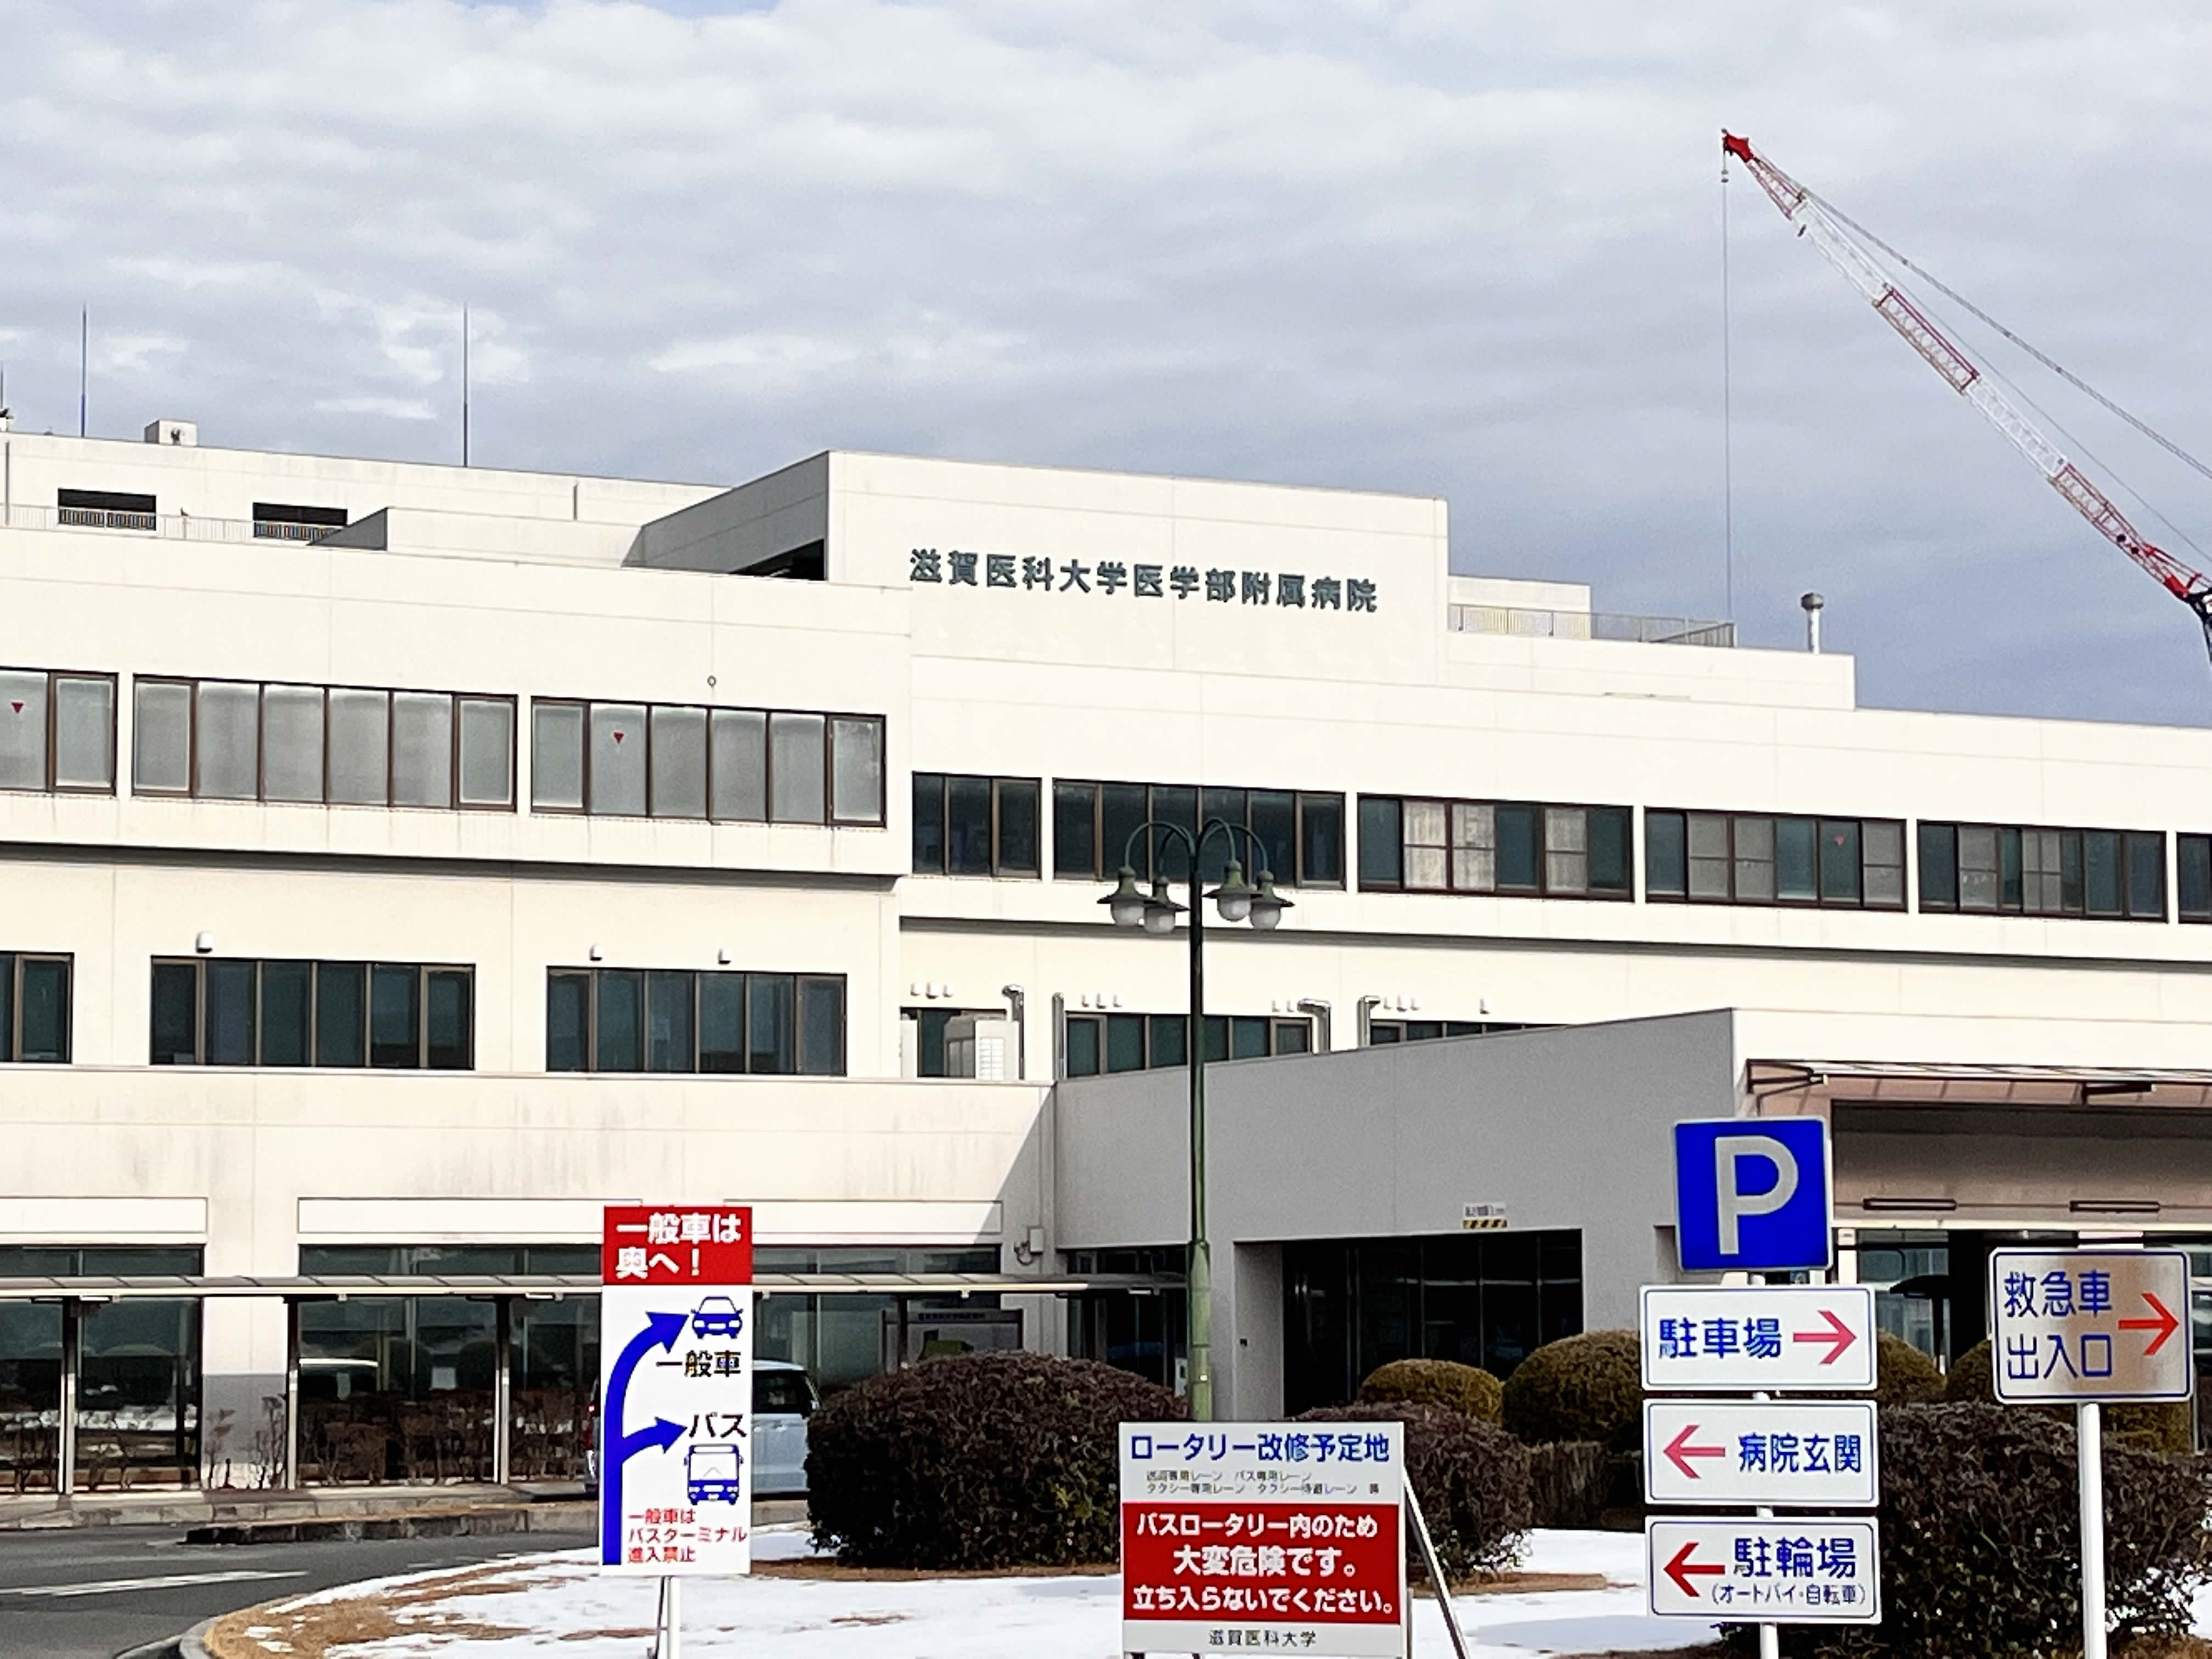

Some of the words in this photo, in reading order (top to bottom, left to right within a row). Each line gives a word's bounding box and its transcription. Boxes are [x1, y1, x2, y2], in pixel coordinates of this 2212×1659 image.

[910, 549, 1378, 613] 滋賀医科大学医学部附属病院
[1714, 1135, 1799, 1255] P
[616, 1212, 742, 1245] 一般車は
[2004, 1269, 2112, 1317] 救急車
[1659, 1317, 1782, 1358] 駐車場
[656, 1350, 741, 1378] 一般車
[2007, 1334, 2112, 1380] 出入口
[689, 1412, 747, 1438] バス
[1131, 1432, 1390, 1463] ロータリー改修予定地
[1737, 1432, 1861, 1474] 病院玄関
[627, 1508, 696, 1524] 一般車は
[1137, 1513, 1378, 1538] バスロータリー内のため
[628, 1527, 748, 1543] バスターミナル
[627, 1546, 696, 1564] 進入禁止
[1173, 1544, 1356, 1577] 大変危険です。
[1733, 1536, 1857, 1579] 駐輪場
[1132, 1584, 1392, 1613] 立ち入らないでください。
[1209, 1629, 1316, 1647] 滋賀医科大学
